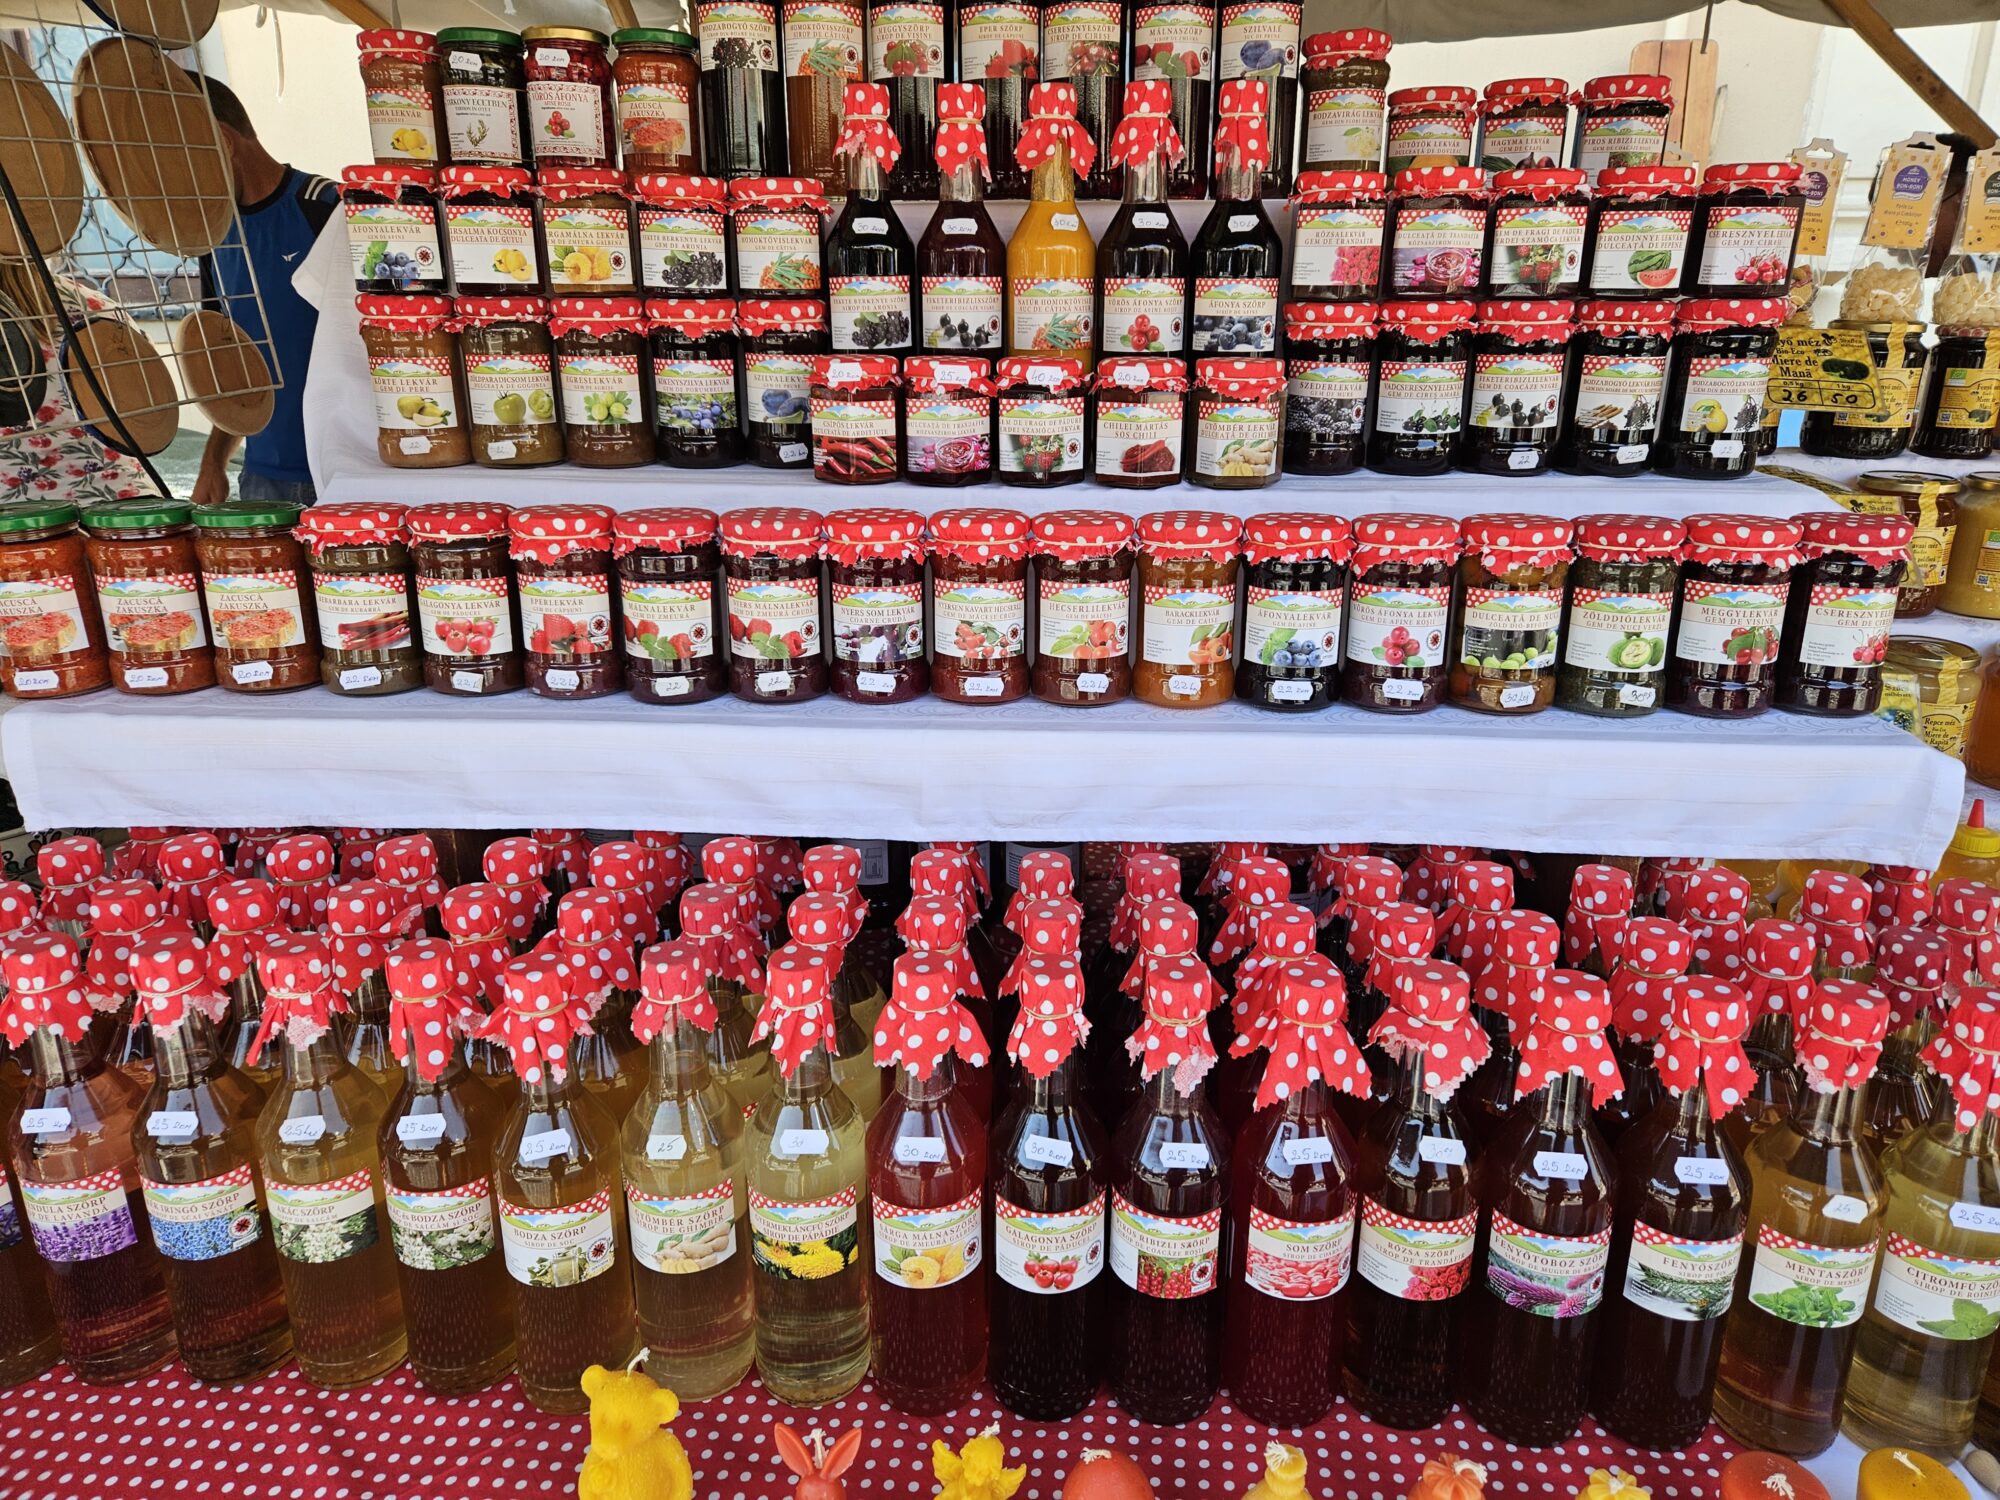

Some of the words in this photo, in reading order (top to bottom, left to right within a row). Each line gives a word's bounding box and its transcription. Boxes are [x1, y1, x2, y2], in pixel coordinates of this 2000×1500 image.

[487, 228, 528, 237] KOCSONYA
[1208, 300, 1241, 309] ÁFONYA
[1242, 300, 1266, 309] SZÖRP
[1805, 356, 1819, 367] de
[374, 377, 398, 386] KÖRTE
[400, 377, 438, 386] LEKVÁR
[565, 375, 623, 385] EGRESLEKVÁR
[1031, 371, 1044, 382] 40
[1299, 381, 1363, 392] SZEDERLEKVÁR
[1830, 393, 1858, 404] 50
[1135, 422, 1169, 431] MÁRTÁS
[1114, 430, 1130, 439] SOS
[218, 601, 269, 610] ZAKUSZKA
[363, 597, 397, 605] LEKVÁR
[465, 600, 501, 609] LEKVÁR
[530, 598, 584, 607] EPERLEKVÁR
[115, 605, 168, 614] ZAKUSZKA
[628, 602, 696, 613] MÁLNALEKVÁR
[841, 606, 864, 616] NYERS
[866, 608, 885, 617] SOM
[886, 606, 916, 617] LEKVÁR
[1165, 608, 1221, 618] BARACKLEKVÁR
[1701, 607, 1779, 619] MEGGYLEKVÁR
[1257, 608, 1332, 621] ÁFONYALEKVÁR
[1377, 608, 1415, 619] ÁFONYA
[1529, 613, 1542, 622] DE
[1582, 611, 1667, 624] ZÖLDDIÓLEKVÁR
[1183, 617, 1196, 625] DE
[1586, 620, 1604, 629] GEM
[1606, 622, 1617, 630] DE
[1704, 616, 1727, 625] GEM
[1837, 619, 1858, 627] GEM
[657, 1137, 680, 1153] 25
[902, 1144, 919, 1157] 30
[1168, 1149, 1188, 1163] 25
[1291, 1147, 1311, 1161] 25
[1541, 1159, 1560, 1173] 25
[1683, 1165, 1703, 1180] 25
[66, 1196, 107, 1212] SZÖRP
[160, 1205, 198, 1214] IRINGÓ
[201, 1192, 240, 1211] SZÖRP
[300, 1205, 335, 1217] SZÖRP
[448, 1202, 481, 1220] SZÖRP
[688, 1205, 726, 1225] SZÖRP
[1958, 1208, 1985, 1225] 25
[825, 1211, 850, 1227] SZÖRP
[662, 1223, 678, 1234] DE
[912, 1213, 977, 1241] MÁLNASZÖRP
[514, 1229, 548, 1241] BODZA
[550, 1225, 587, 1241] SZÖRP
[1004, 1226, 1067, 1244] GALAGONYA
[1069, 1222, 1098, 1242] SZÖRP
[1039, 1243, 1053, 1252] DE
[1139, 1235, 1177, 1250] RIBIZLI
[1286, 1242, 1309, 1253] SOM
[1312, 1238, 1343, 1252] SZÖRP
[1387, 1241, 1420, 1257] RÓZSA
[1424, 1249, 1455, 1258] SZÖRP
[1402, 1256, 1415, 1264] DE
[1784, 1260, 1870, 1279] MENTASZÖRP
[1795, 1273, 1822, 1286] SIROP
[1823, 1278, 1835, 1287] DE
[1913, 1278, 1946, 1293] SIROP
